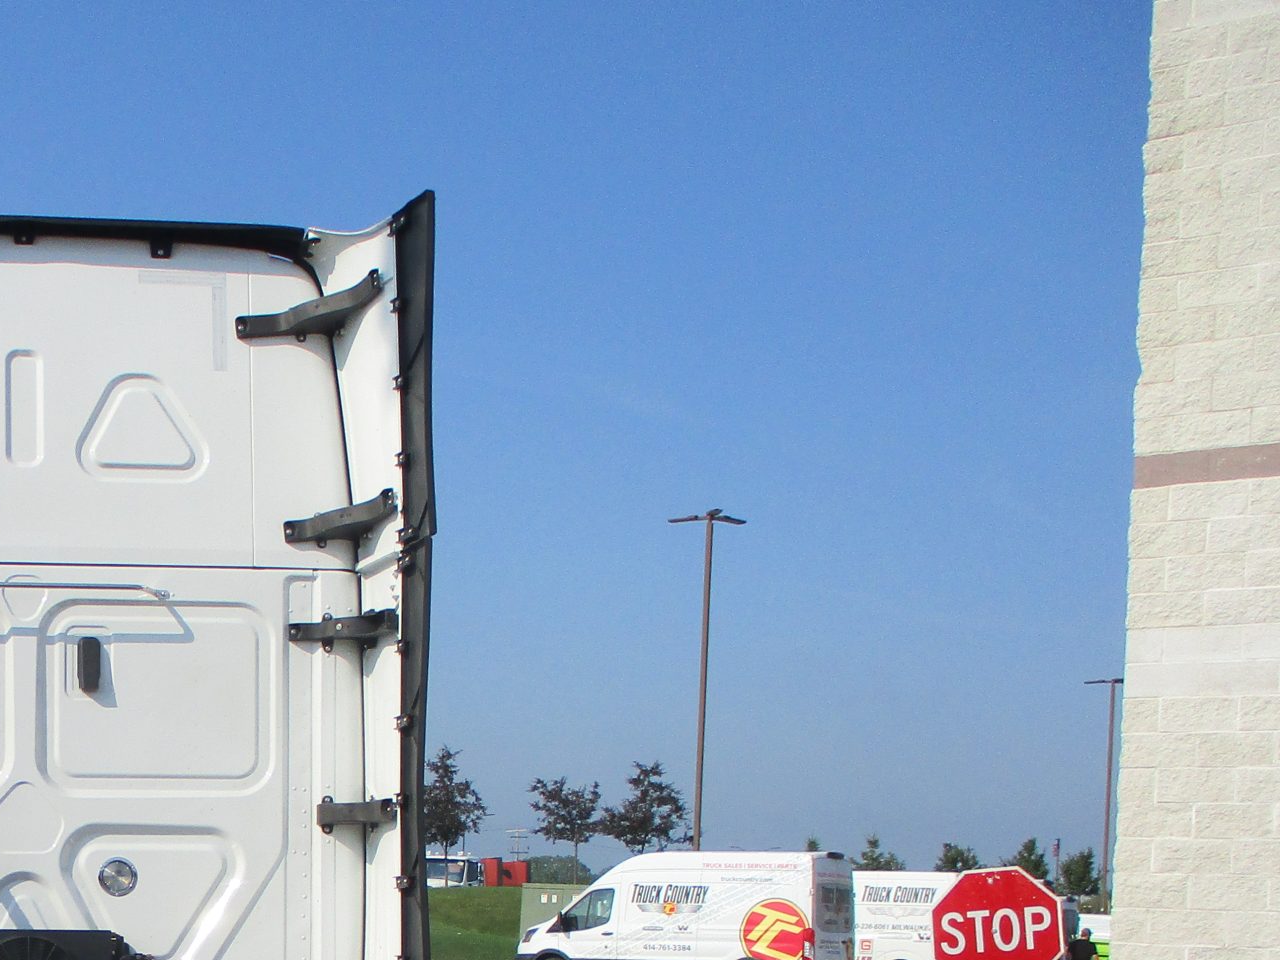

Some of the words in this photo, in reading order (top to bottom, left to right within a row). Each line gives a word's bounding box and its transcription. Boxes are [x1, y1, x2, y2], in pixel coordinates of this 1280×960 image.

[631, 884, 663, 904] TRUCK
[663, 884, 710, 904] COUNTRY
[861, 885, 892, 902] TRUCK
[893, 886, 937, 903] COUNTRY
[940, 906, 1052, 955] STOP
[642, 944, 692, 952] 414-761-3384
